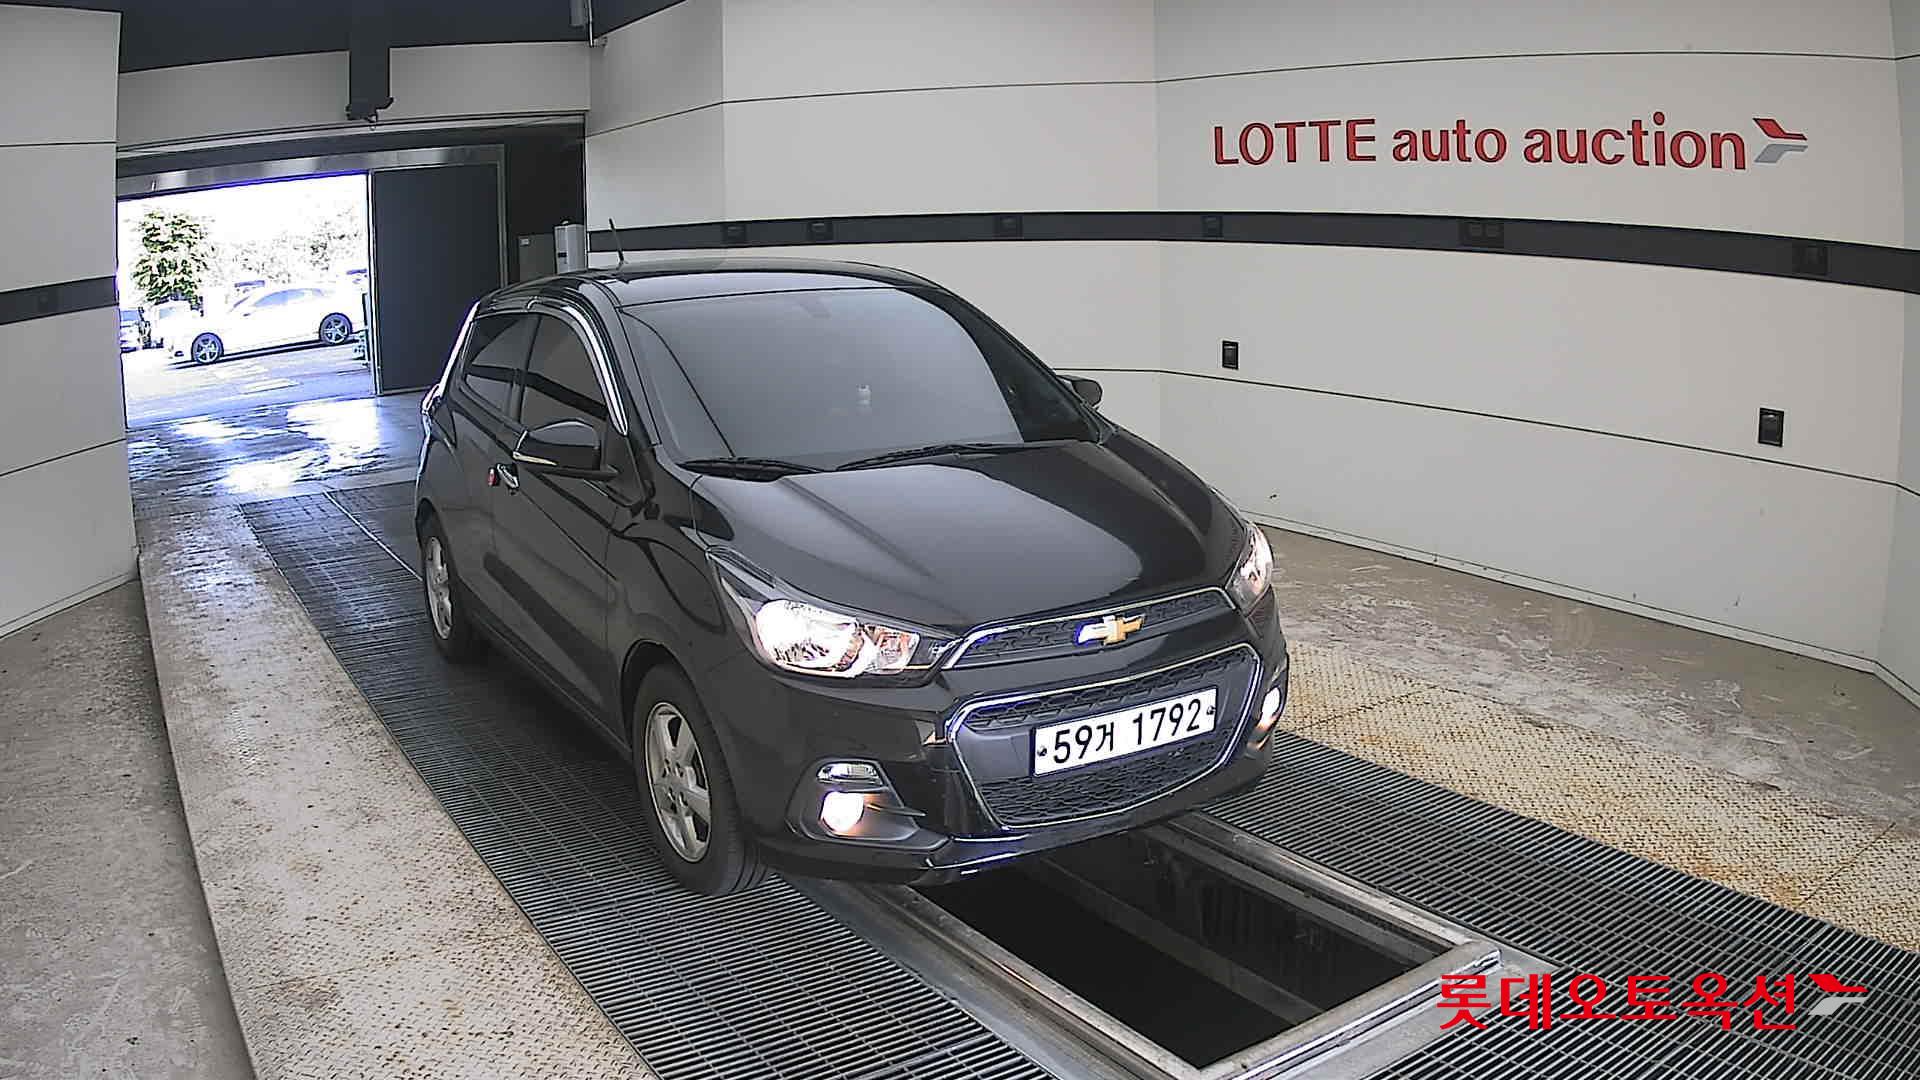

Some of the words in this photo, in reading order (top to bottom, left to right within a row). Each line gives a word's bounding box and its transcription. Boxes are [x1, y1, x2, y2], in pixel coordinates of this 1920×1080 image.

[1213, 118, 1376, 165] LOTTE
[1392, 119, 1507, 163] auto
[1523, 111, 1747, 170] auction
[1053, 721, 1115, 763] 59거
[1132, 698, 1201, 745] 1792
